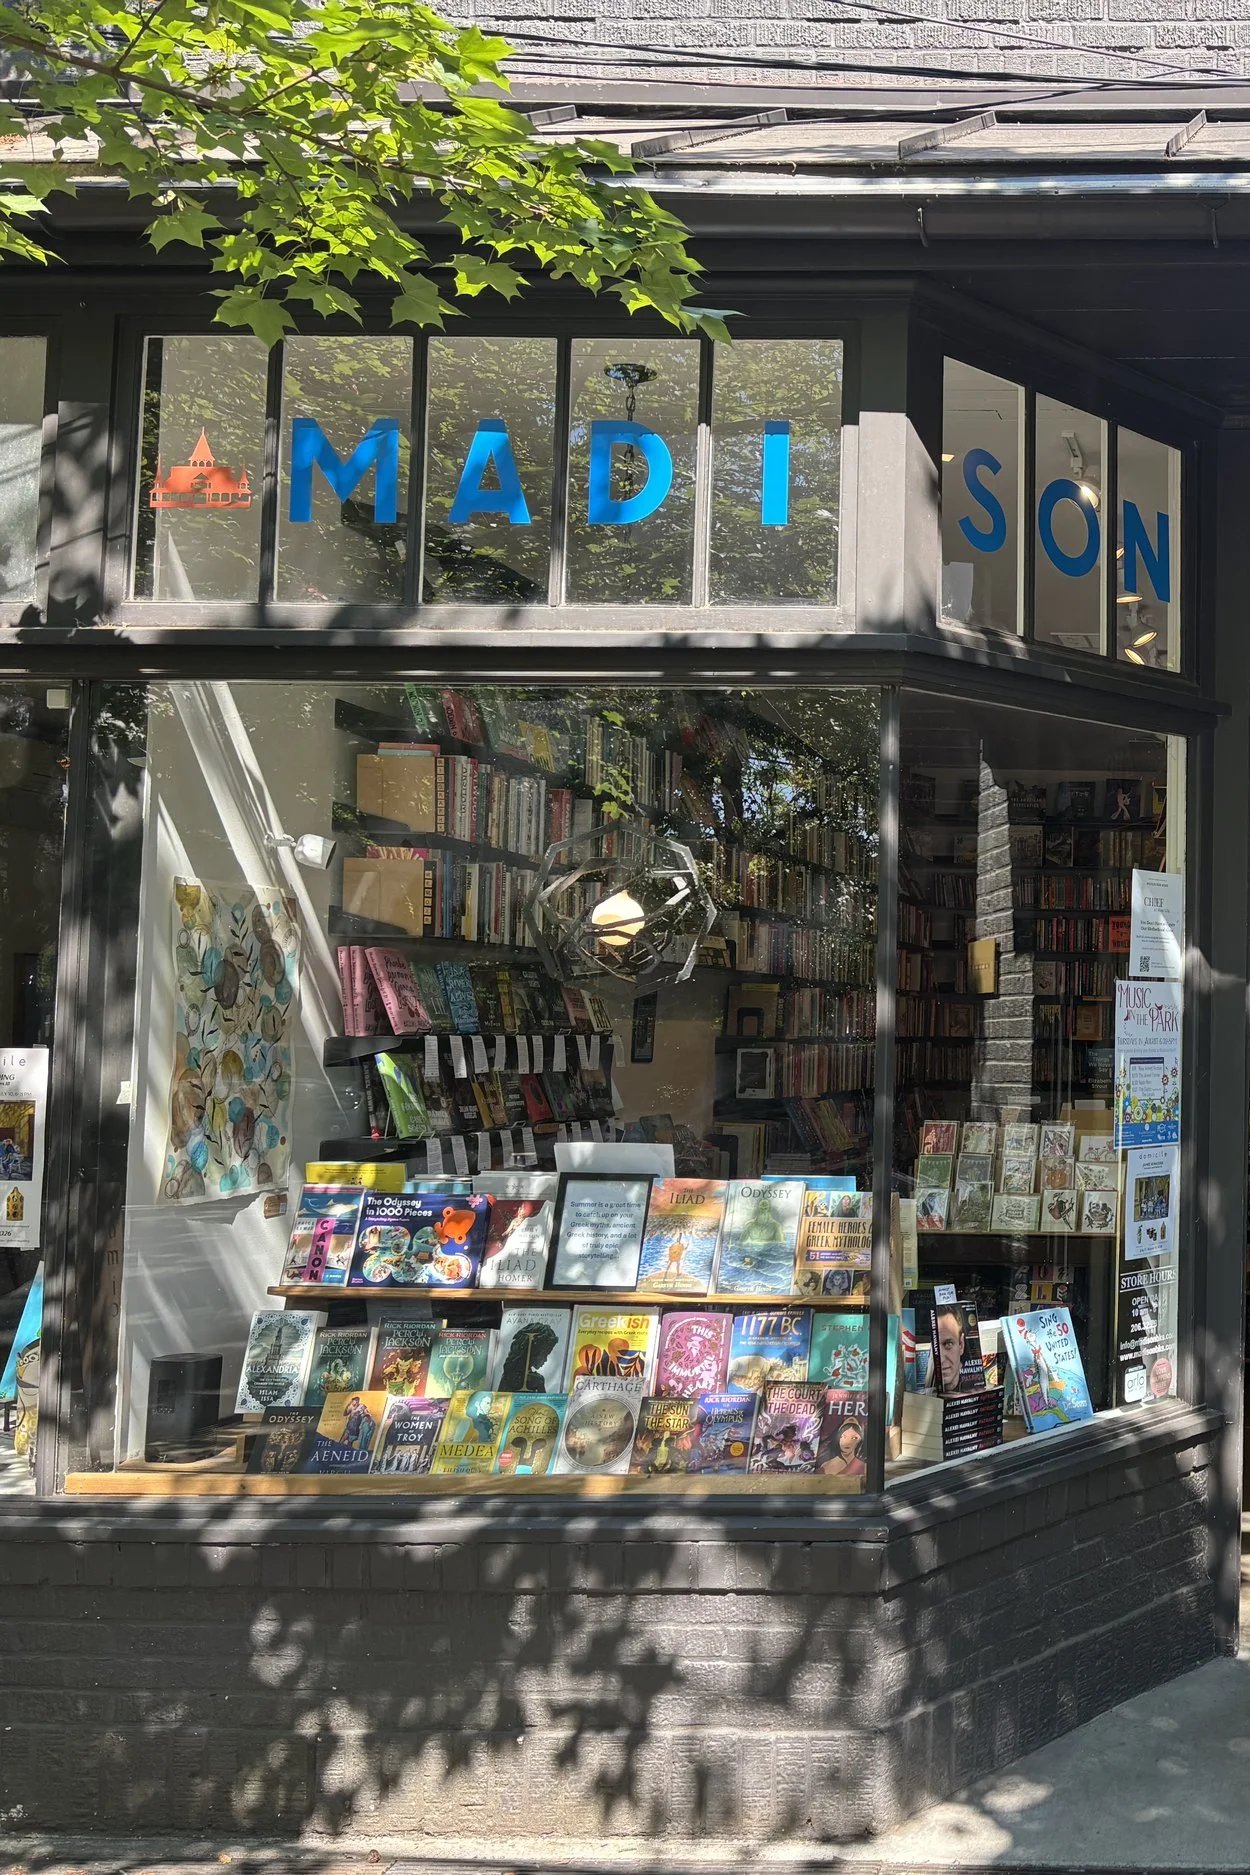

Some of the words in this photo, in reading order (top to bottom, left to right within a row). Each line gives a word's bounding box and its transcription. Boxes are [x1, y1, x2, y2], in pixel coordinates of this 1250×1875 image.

[958, 447, 1171, 603] SON
[470, 768, 479, 822] ATWOOD
[1117, 983, 1151, 1009] MUSIC
[1136, 1013, 1148, 1026] THE
[1149, 1007, 1179, 1032] PARK
[1092, 1056, 1111, 1064] Things
[1138, 1150, 1168, 1160] domicile
[669, 1193, 705, 1205] ILIAD
[741, 1187, 792, 1199] ODYSSEY
[367, 1197, 382, 1205] The
[384, 1197, 422, 1207] Odyssey
[366, 1207, 374, 1215] in
[376, 1207, 403, 1216] 1000
[404, 1208, 433, 1217] Pieces
[807, 1221, 834, 1234] FEMALE
[838, 1221, 866, 1234] HEROES
[806, 1236, 831, 1248] GREEK
[833, 1236, 871, 1248] MYTHOLOG
[309, 1220, 330, 1281] CANON
[515, 1248, 537, 1256] THE
[809, 1252, 819, 1260] 51
[491, 1259, 537, 1271] ILIAD
[1120, 1273, 1149, 1289] STORE
[1149, 1269, 1177, 1283] HOURS
[1132, 1296, 1149, 1306] OPEN
[1132, 1308, 1139, 1317] 10
[579, 1313, 649, 1328] Greekish
[741, 1316, 776, 1336] 1177
[1039, 1313, 1057, 1330] SING
[392, 1330, 425, 1338] PERCY
[691, 1325, 714, 1340] THIS
[1046, 1329, 1057, 1337] the
[1057, 1322, 1069, 1336] 50
[327, 1338, 356, 1346] PERCY
[383, 1337, 431, 1349] JACKSON
[446, 1338, 475, 1346] PERCY
[1045, 1340, 1069, 1352] UNITED
[318, 1344, 363, 1355] JACKSON
[438, 1344, 483, 1356] JACKSON
[1053, 1348, 1077, 1365] STATES!
[246, 1365, 299, 1374] ALEXANDRIA
[960, 1366, 983, 1375] NAVALNY
[576, 1381, 641, 1392] CARTHAGE
[1127, 1374, 1145, 1389] arlo
[682, 1379, 715, 1398] HEART
[767, 1387, 786, 1399] THE
[788, 1388, 822, 1400] COURT
[961, 1396, 979, 1406] NAVALNY
[1063, 1399, 1072, 1409] Dr.
[1072, 1399, 1087, 1409] Seuss
[650, 1404, 668, 1414] THE
[671, 1404, 689, 1415] SUN
[768, 1403, 787, 1414] THE
[788, 1403, 816, 1414] DEAD
[829, 1401, 868, 1416] HER
[269, 1415, 314, 1423] ODYSSEY
[515, 1416, 541, 1424] SONG
[544, 1416, 557, 1424] OF
[645, 1417, 665, 1428] THE
[666, 1417, 689, 1429] STAR
[394, 1421, 433, 1430] WOMEN
[509, 1425, 557, 1433] ACHILLES
[397, 1433, 423, 1442] TROY
[310, 1451, 369, 1462] AENEID
[440, 1444, 494, 1457] MEDEA
